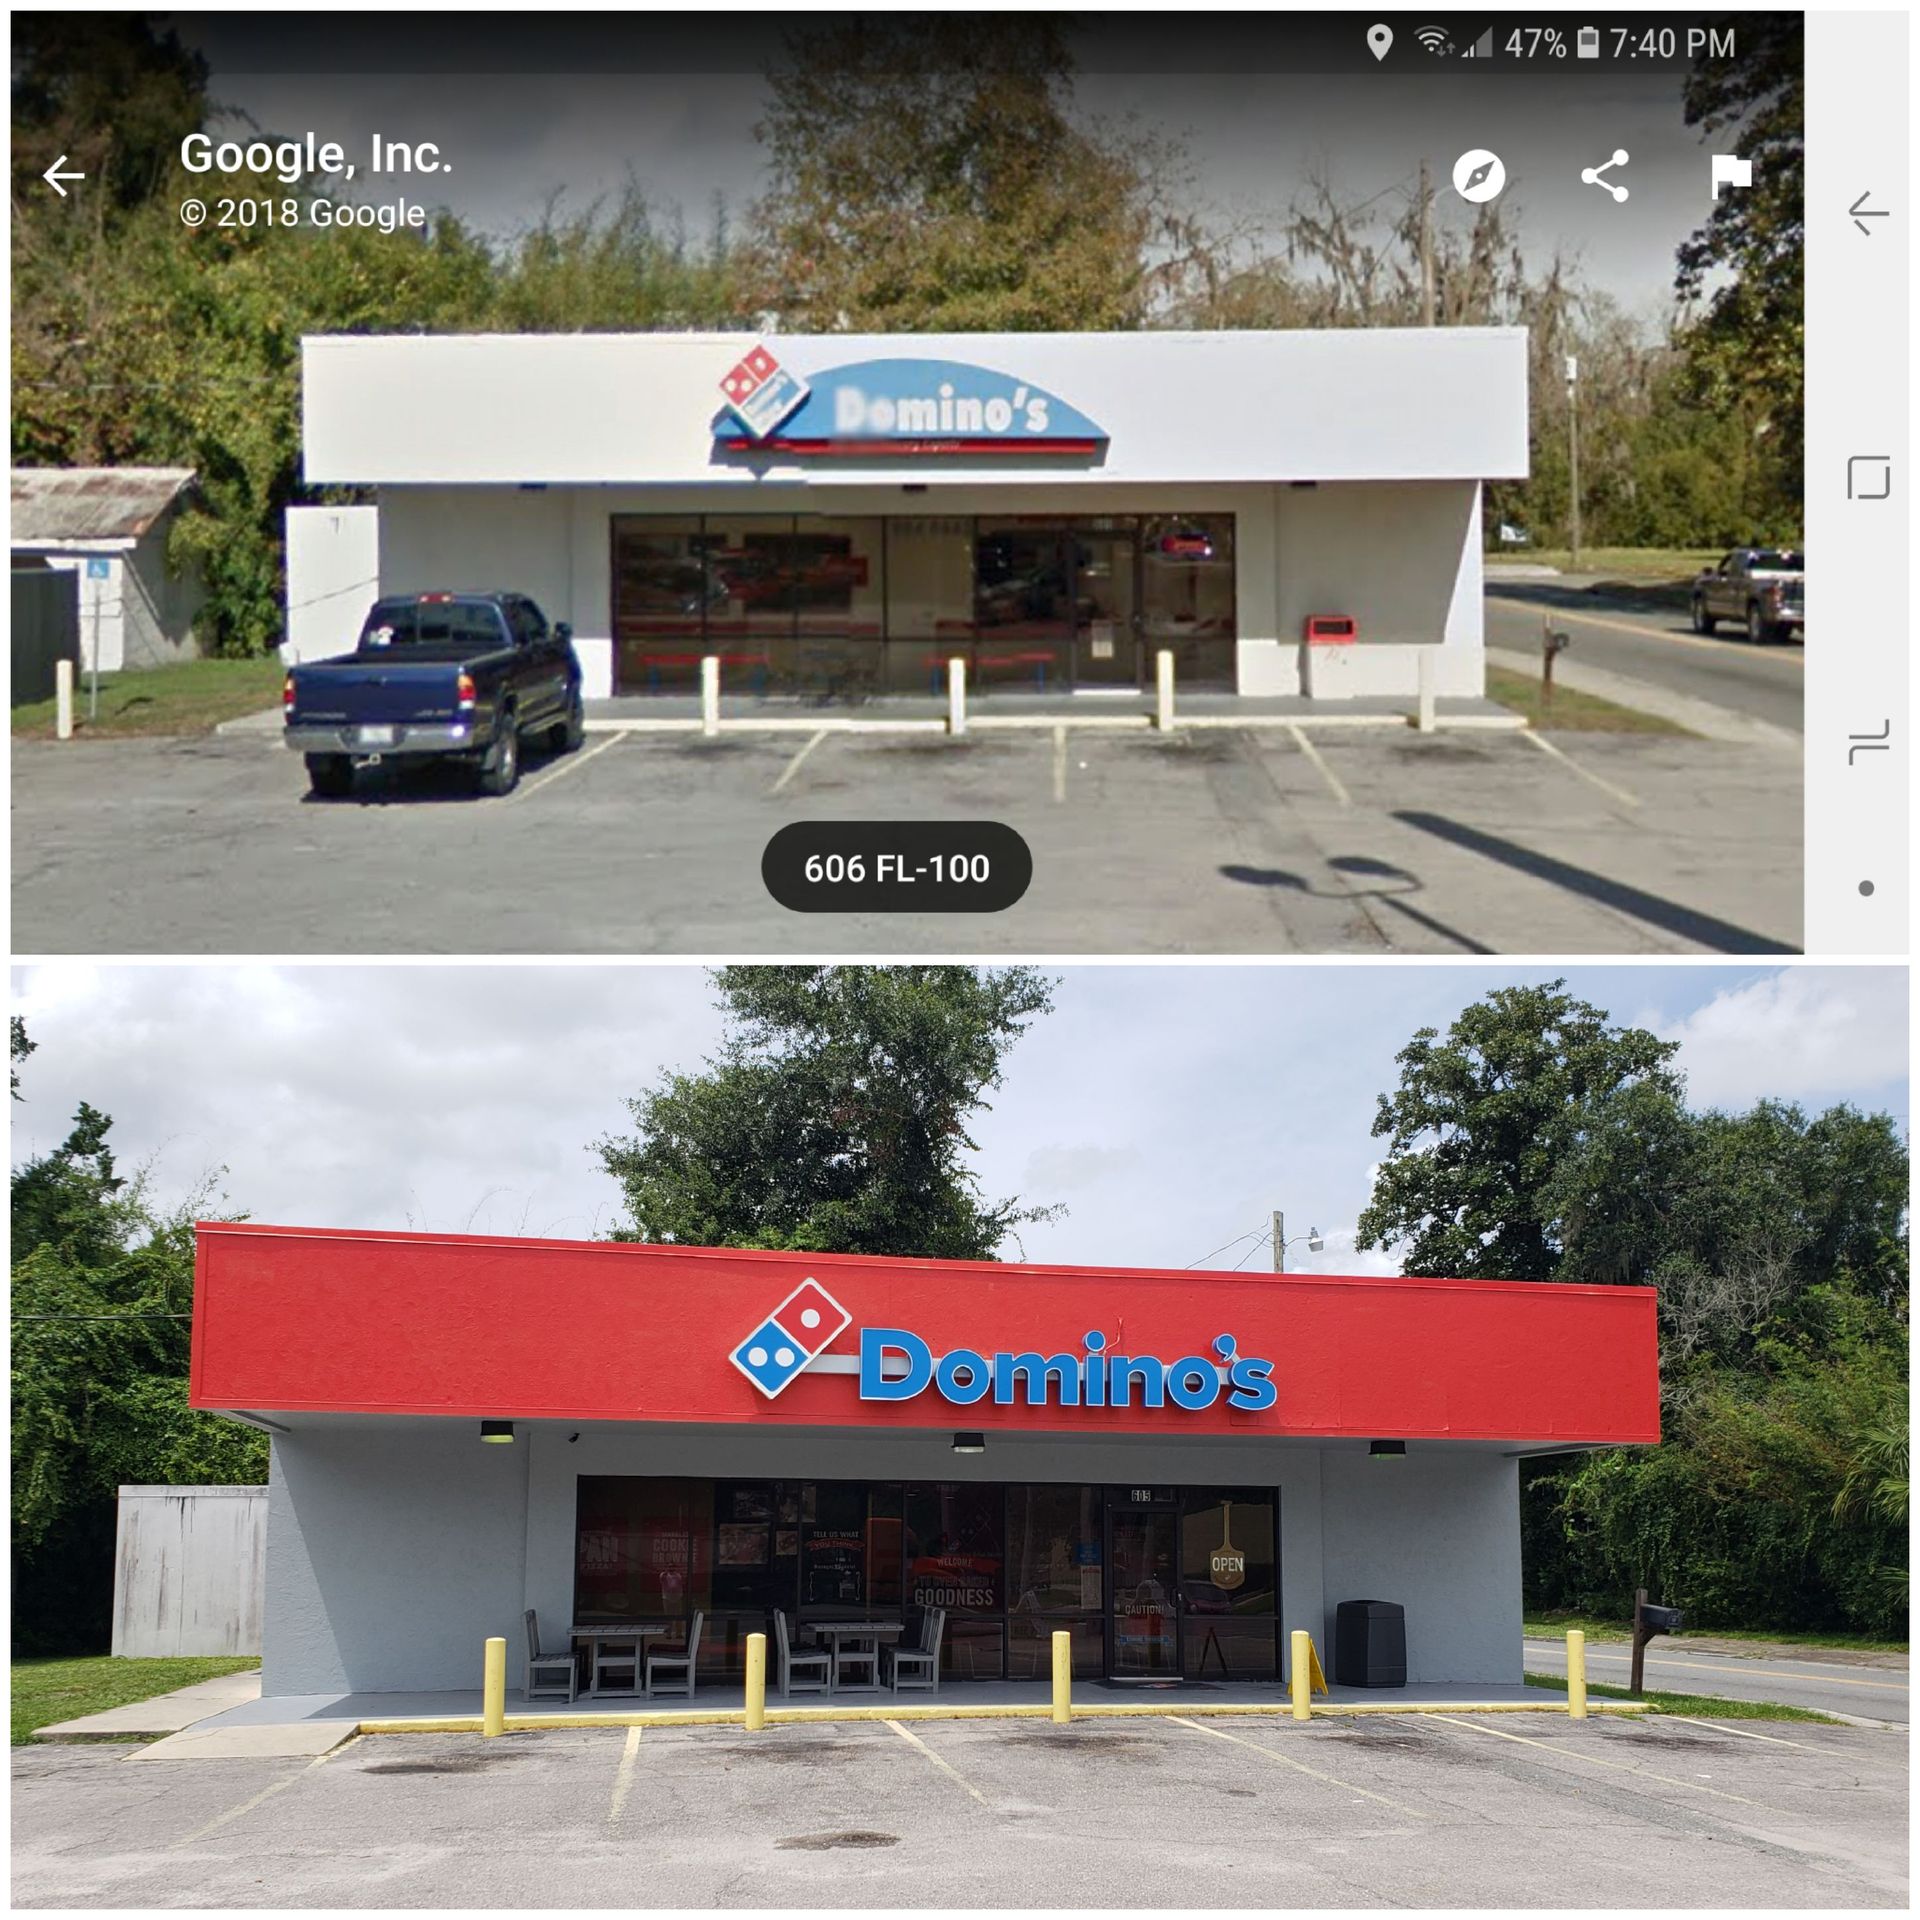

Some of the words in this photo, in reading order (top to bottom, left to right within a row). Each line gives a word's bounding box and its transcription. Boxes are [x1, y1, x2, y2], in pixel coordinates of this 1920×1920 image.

[834, 383, 1049, 433] Domino's
[859, 1327, 1278, 1412] Domino's
[1132, 1489, 1151, 1501] 605
[813, 1530, 827, 1538] TELL
[839, 1530, 860, 1538] WHAT
[652, 1552, 697, 1563] BROWNE
[936, 1557, 973, 1568] WELCOME
[1212, 1557, 1244, 1572] OPEN
[914, 1588, 994, 1606] GOODNESS
